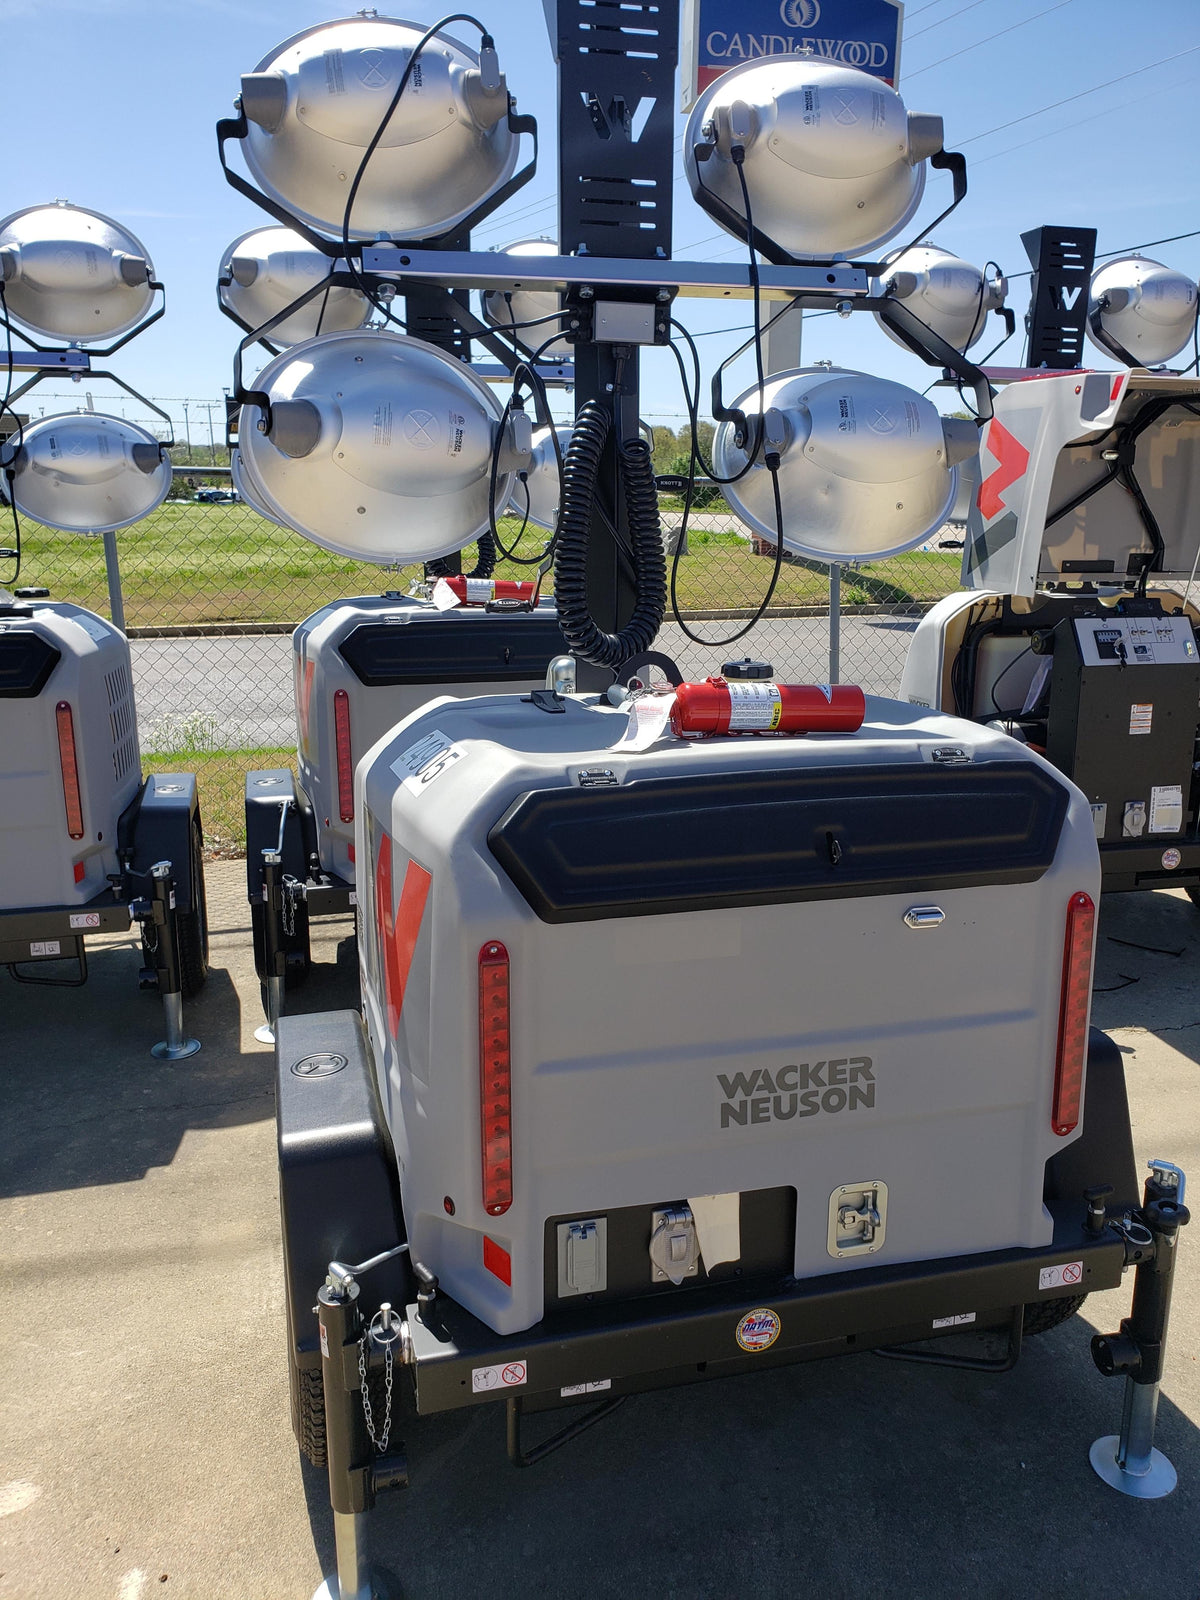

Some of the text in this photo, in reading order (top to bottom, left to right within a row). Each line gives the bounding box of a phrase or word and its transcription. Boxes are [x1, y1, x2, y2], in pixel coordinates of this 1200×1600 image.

[772, 708, 780, 726] ABC
[716, 1056, 876, 1100] WACKER
[720, 1083, 876, 1129] NEUSON
